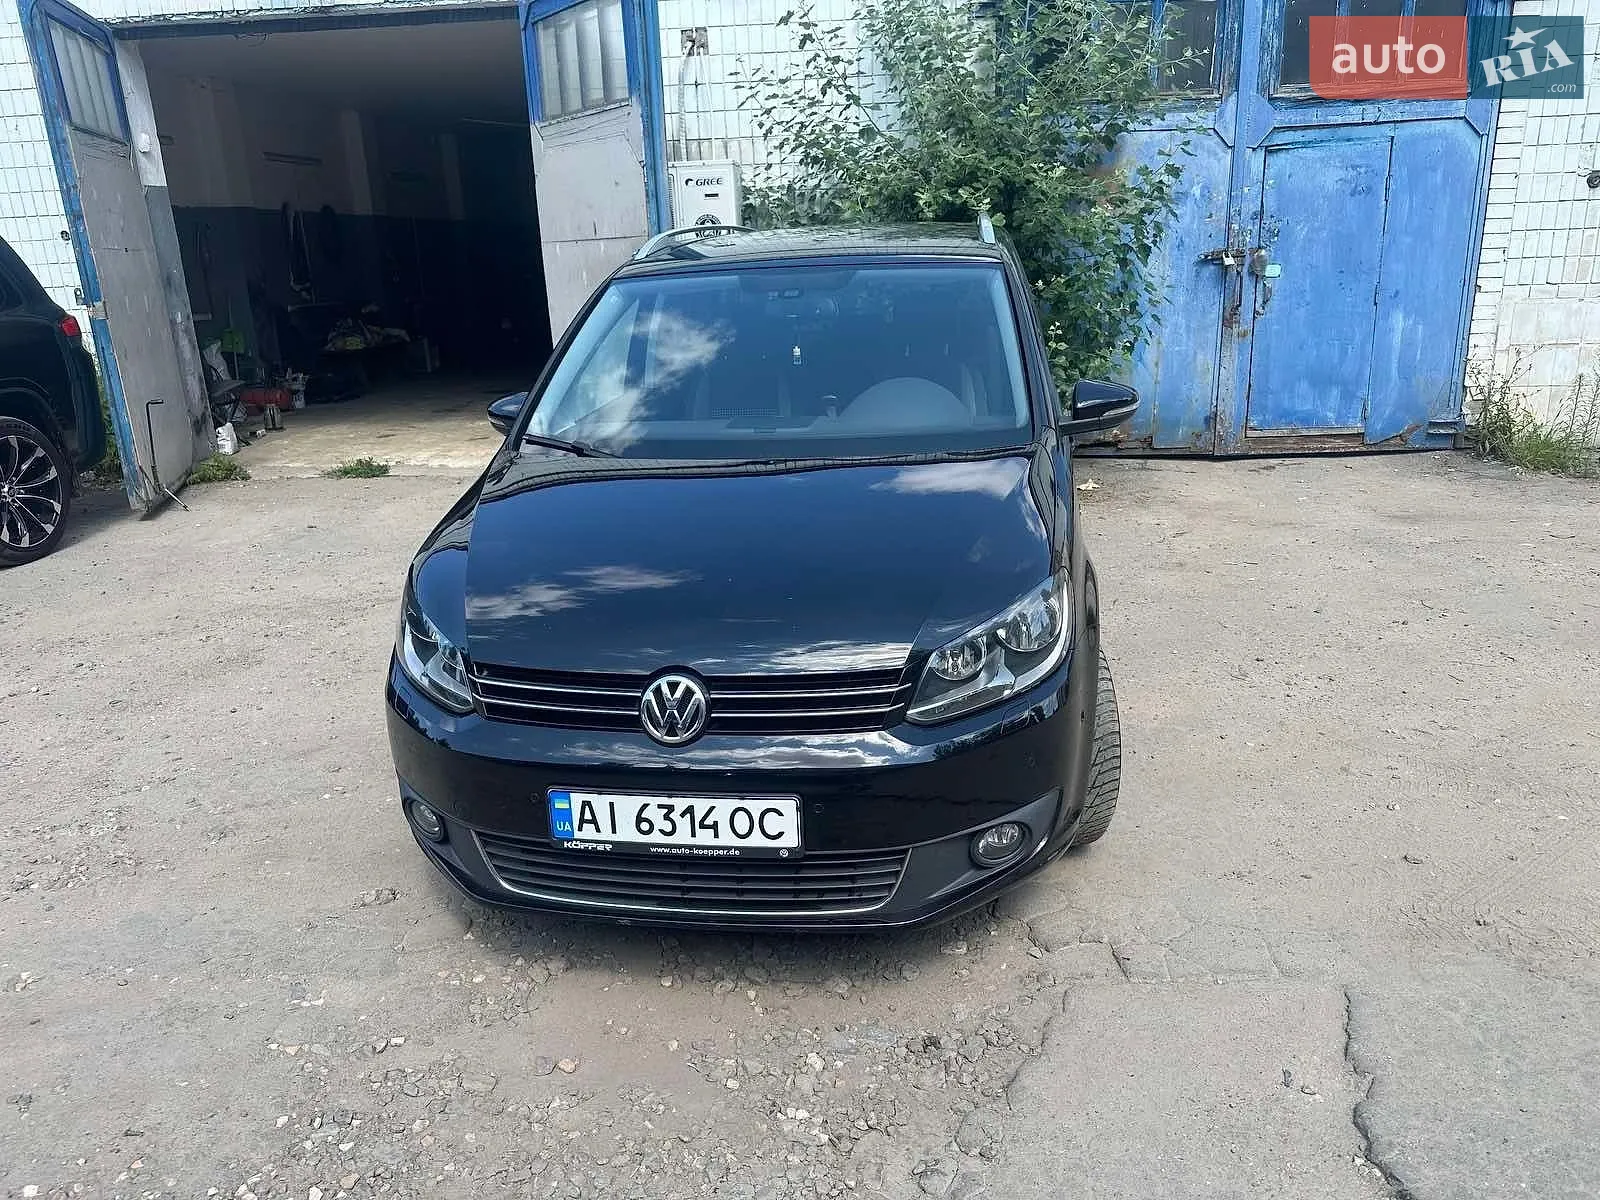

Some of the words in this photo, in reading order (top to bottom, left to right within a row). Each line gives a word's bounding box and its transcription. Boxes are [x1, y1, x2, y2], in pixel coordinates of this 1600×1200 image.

[695, 177, 723, 186] GREE
[577, 800, 617, 834] AI
[635, 803, 719, 839] 6314
[729, 806, 785, 840] OC
[556, 822, 571, 832] UA
[563, 841, 613, 851] KÖPPER
[650, 846, 740, 856] www.auto-koepper.de
